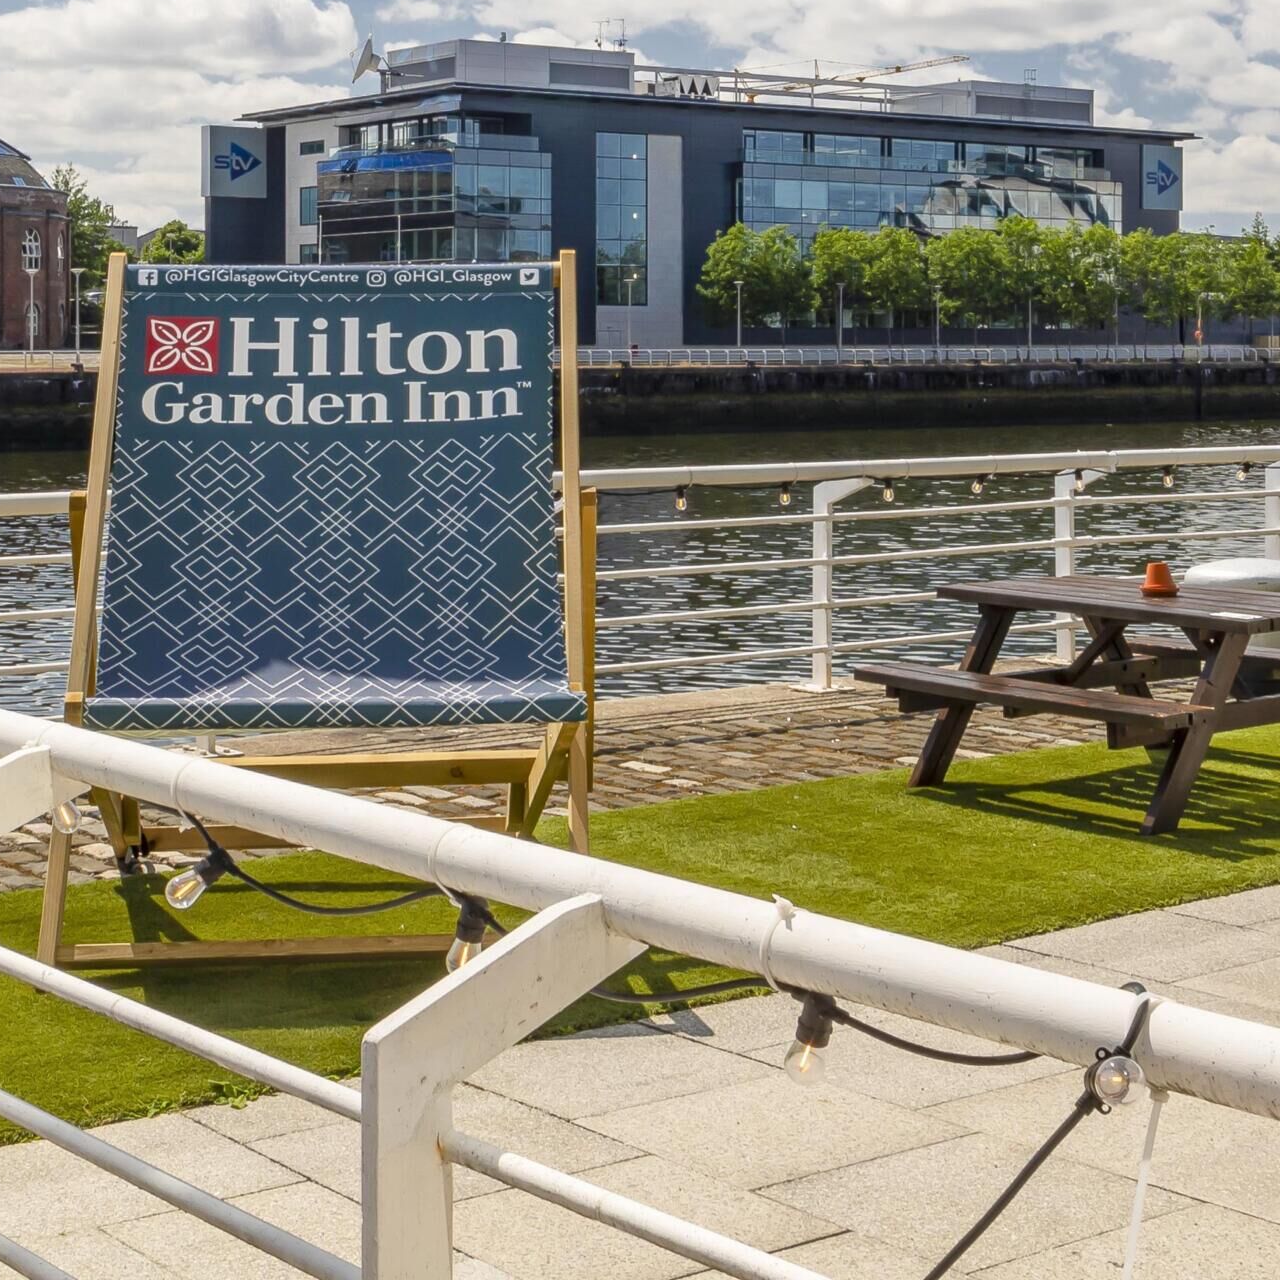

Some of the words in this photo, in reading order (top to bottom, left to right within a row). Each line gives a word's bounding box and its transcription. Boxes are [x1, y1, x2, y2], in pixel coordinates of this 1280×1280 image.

[394, 269, 512, 286] @HGI_Glasgow
[227, 317, 522, 376] Hilton
[141, 381, 393, 425] Garden
